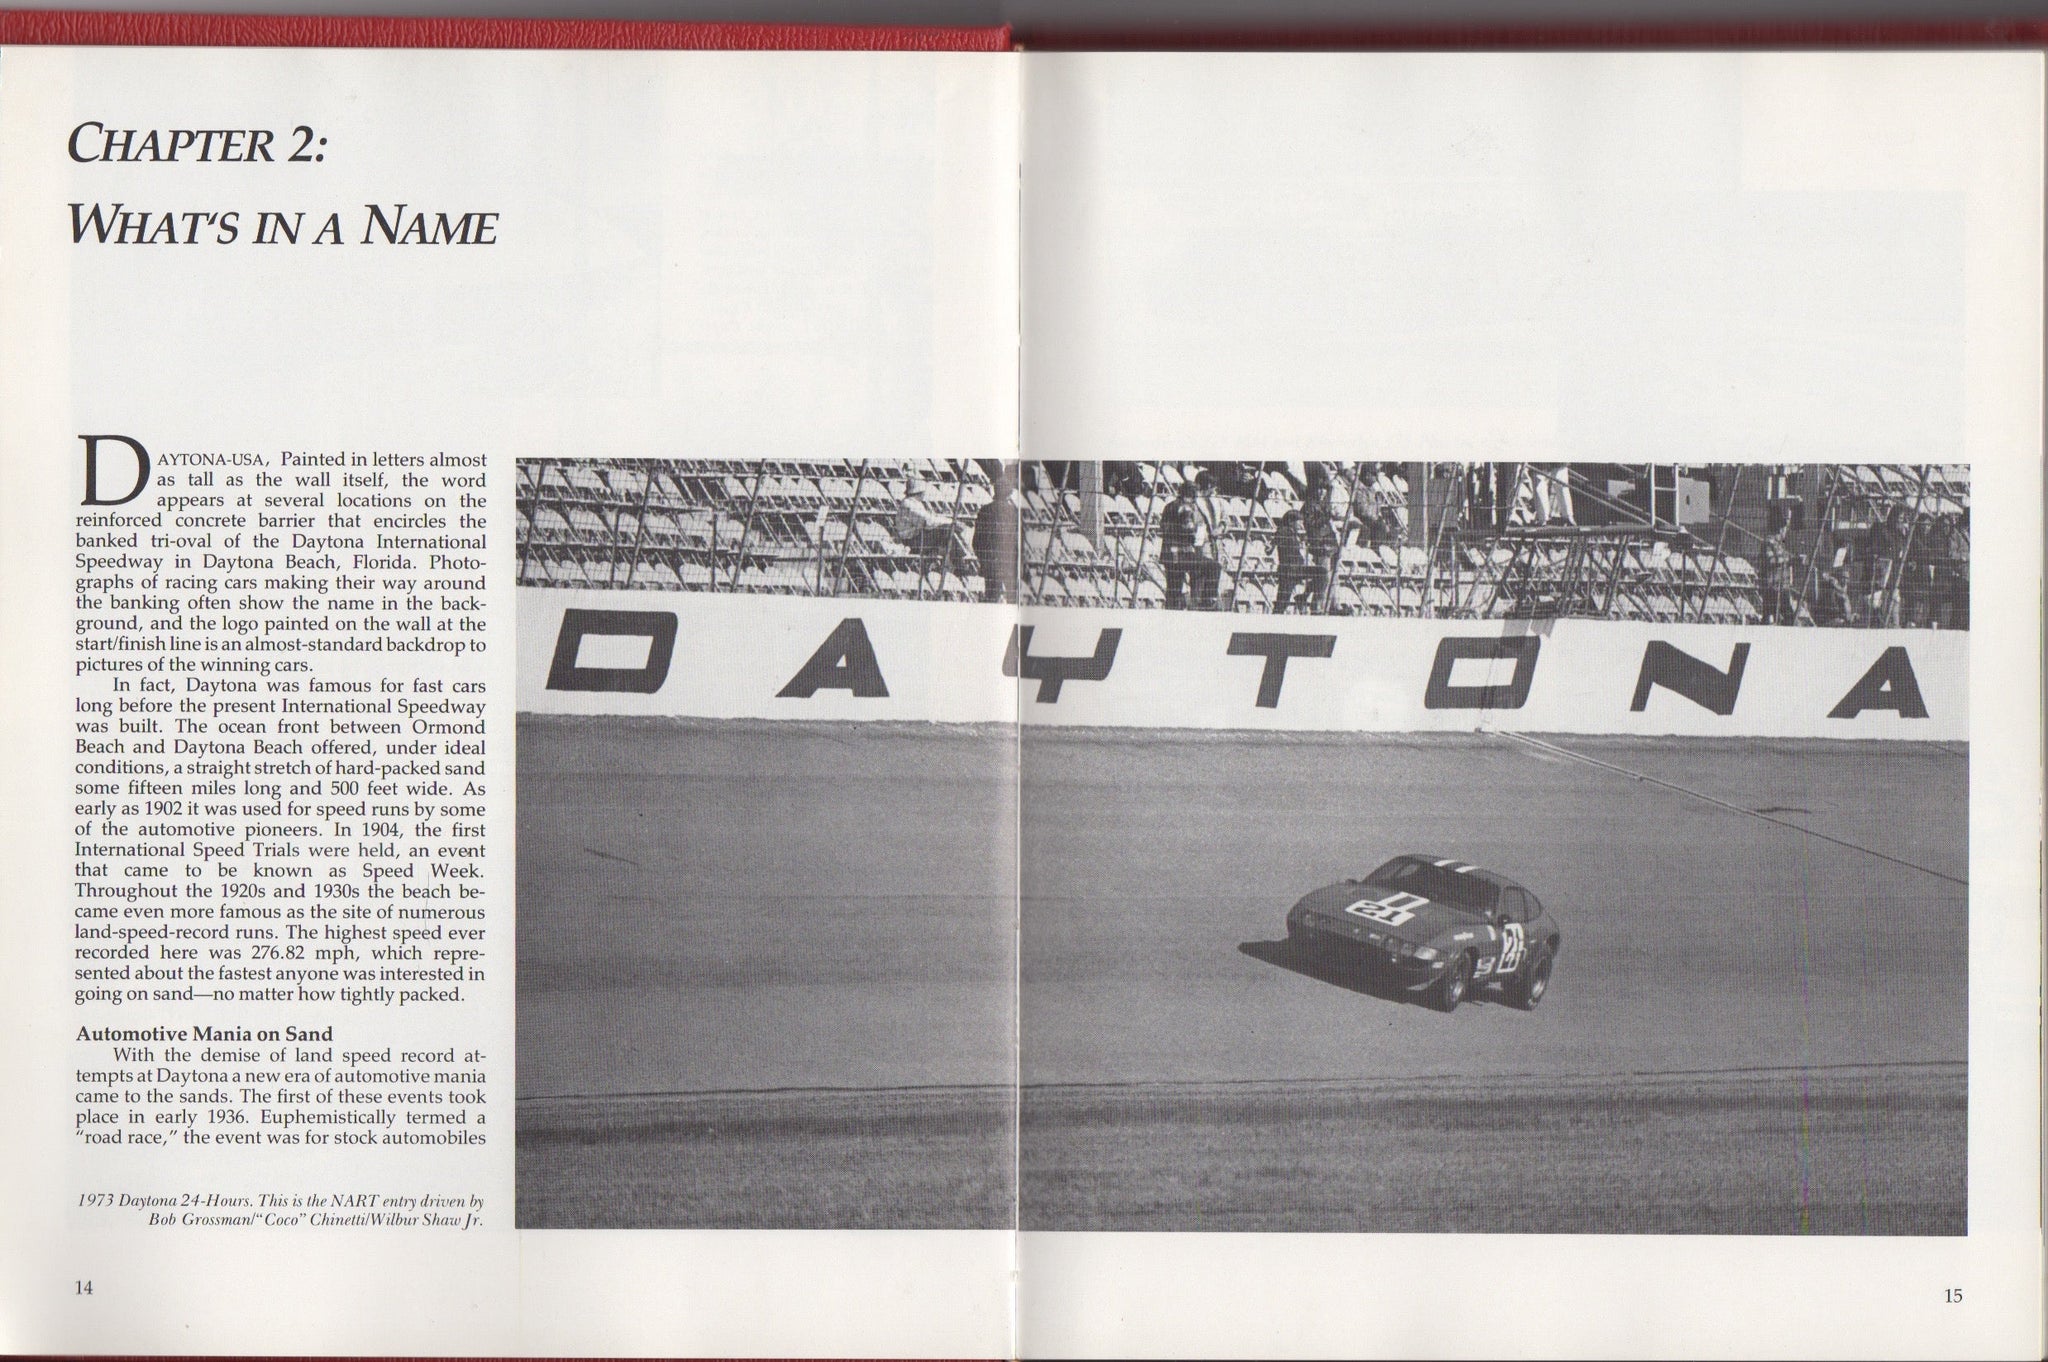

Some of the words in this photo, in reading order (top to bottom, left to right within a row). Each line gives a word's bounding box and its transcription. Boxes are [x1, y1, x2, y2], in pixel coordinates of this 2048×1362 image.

[68, 120, 275, 163] CHAPTER
[287, 125, 328, 163] 2:
[251, 212, 306, 245] IN
[311, 212, 345, 245] A
[360, 203, 500, 246] NAME
[281, 450, 346, 467] Painted
[351, 451, 368, 467] in
[372, 451, 425, 467] letters
[429, 451, 488, 468] almost
[156, 475, 176, 487] as
[188, 471, 214, 487] tall
[225, 475, 244, 487] as
[255, 471, 283, 487] the
[295, 471, 331, 487] wall
[343, 471, 389, 490] itself,
[401, 471, 429, 488] the
[441, 472, 487, 488] word
[75, 511, 163, 528] reinforced
[175, 514, 247, 528] concrete
[258, 512, 316, 528] barrier
[328, 512, 362, 528] that
[373, 512, 447, 529] encircles
[459, 512, 487, 529] the
[75, 532, 138, 548] banked
[151, 532, 212, 549] tri-oval
[223, 532, 242, 549] of
[252, 532, 280, 549] the
[292, 533, 364, 554] Daytona
[376, 533, 487, 550] International
[75, 573, 134, 594] graphs
[140, 573, 159, 590] of
[165, 574, 218, 595] racing
[224, 578, 258, 590] cars
[264, 574, 329, 595] making
[335, 574, 376, 590] their
[382, 579, 417, 595] way
[423, 575, 486, 591] around
[545, 608, 1930, 719] DAYTONA
[112, 676, 131, 692] In
[140, 676, 176, 695] fact,
[186, 676, 257, 698] Daytona
[266, 681, 300, 693] was
[309, 677, 372, 693] famous
[380, 677, 405, 693] for
[413, 677, 444, 693] fast
[452, 682, 487, 694] cars
[75, 696, 113, 718] long
[118, 696, 173, 713] before
[179, 697, 207, 713] the
[213, 699, 276, 718] present
[281, 697, 392, 714] International
[397, 698, 487, 719] Speedway
[75, 738, 125, 754] Beach
[132, 738, 166, 754] and
[174, 738, 246, 759] Daytona
[253, 738, 303, 755] Beach
[311, 738, 377, 757] offered,
[385, 739, 438, 755] under
[444, 739, 486, 755] ideal
[75, 783, 120, 795] some
[127, 778, 183, 795] fifteen
[191, 779, 237, 796] miles
[244, 779, 282, 801] long
[289, 780, 322, 796] and
[330, 780, 359, 796] 500
[367, 779, 399, 796] feet
[406, 780, 453, 796] wide.
[462, 781, 486, 797] As
[74, 861, 109, 877] that
[124, 866, 169, 878] came
[184, 863, 202, 878] to
[217, 861, 238, 878] be
[253, 862, 313, 878] known
[328, 866, 347, 878] as
[362, 862, 414, 883] Speed
[430, 862, 484, 879] Week.
[74, 882, 178, 903] Throughout
[185, 882, 213, 898] the
[221, 883, 266, 899] 1920s
[273, 882, 306, 899] and
[314, 883, 360, 899] 1930s
[367, 883, 395, 899] the
[401, 883, 451, 899] beach
[458, 883, 486, 899] be-
[74, 923, 230, 945] land-speed-record
[235, 928, 279, 940] runs.
[285, 923, 319, 940] The
[324, 924, 387, 945] highest
[392, 924, 442, 945] speed
[448, 929, 486, 941] ever
[74, 964, 131, 980] sented
[134, 964, 184, 981] about
[187, 964, 215, 981] the
[218, 964, 273, 981] fastest
[275, 969, 339, 986] anyone
[342, 969, 376, 981] was
[379, 965, 465, 981] interested
[468, 966, 485, 981] in
[75, 1025, 188, 1042] Automotive
[192, 1025, 252, 1042] Mania
[256, 1030, 281, 1042] on
[285, 1025, 334, 1042] Sand
[75, 1069, 134, 1088] tempts
[136, 1069, 153, 1083] at
[156, 1067, 229, 1088] Daytona
[231, 1071, 241, 1083] a
[245, 1072, 281, 1083] new
[284, 1072, 311, 1083] era
[314, 1067, 332, 1083] of
[334, 1068, 431, 1084] automotive
[434, 1068, 487, 1084] mania
[75, 1108, 119, 1129] place
[128, 1109, 145, 1124] in
[155, 1108, 198, 1129] early
[208, 1108, 249, 1124] 1936.
[260, 1108, 396, 1129] Euphemistically
[406, 1109, 467, 1125] termed
[476, 1113, 486, 1125] a
[183, 1128, 211, 1145] the
[215, 1131, 262, 1145] event
[266, 1133, 300, 1145] was
[305, 1129, 330, 1145] for
[334, 1129, 378, 1145] stock
[382, 1129, 487, 1145] automobiles
[78, 1193, 114, 1208] 1973
[118, 1193, 177, 1211] Daytona
[180, 1193, 254, 1208] 24-Hours.
[258, 1193, 289, 1208] This
[292, 1194, 303, 1208] is
[306, 1194, 328, 1208] the
[330, 1194, 381, 1208] NART
[382, 1196, 417, 1212] entry
[419, 1194, 466, 1208] driven
[468, 1194, 485, 1212] by
[148, 1212, 176, 1226] Bob
[421, 1212, 462, 1227] Shaw
[461, 1212, 484, 1231] Jr.
[75, 1280, 93, 1295] 14
[1945, 1288, 1963, 1303] 15
